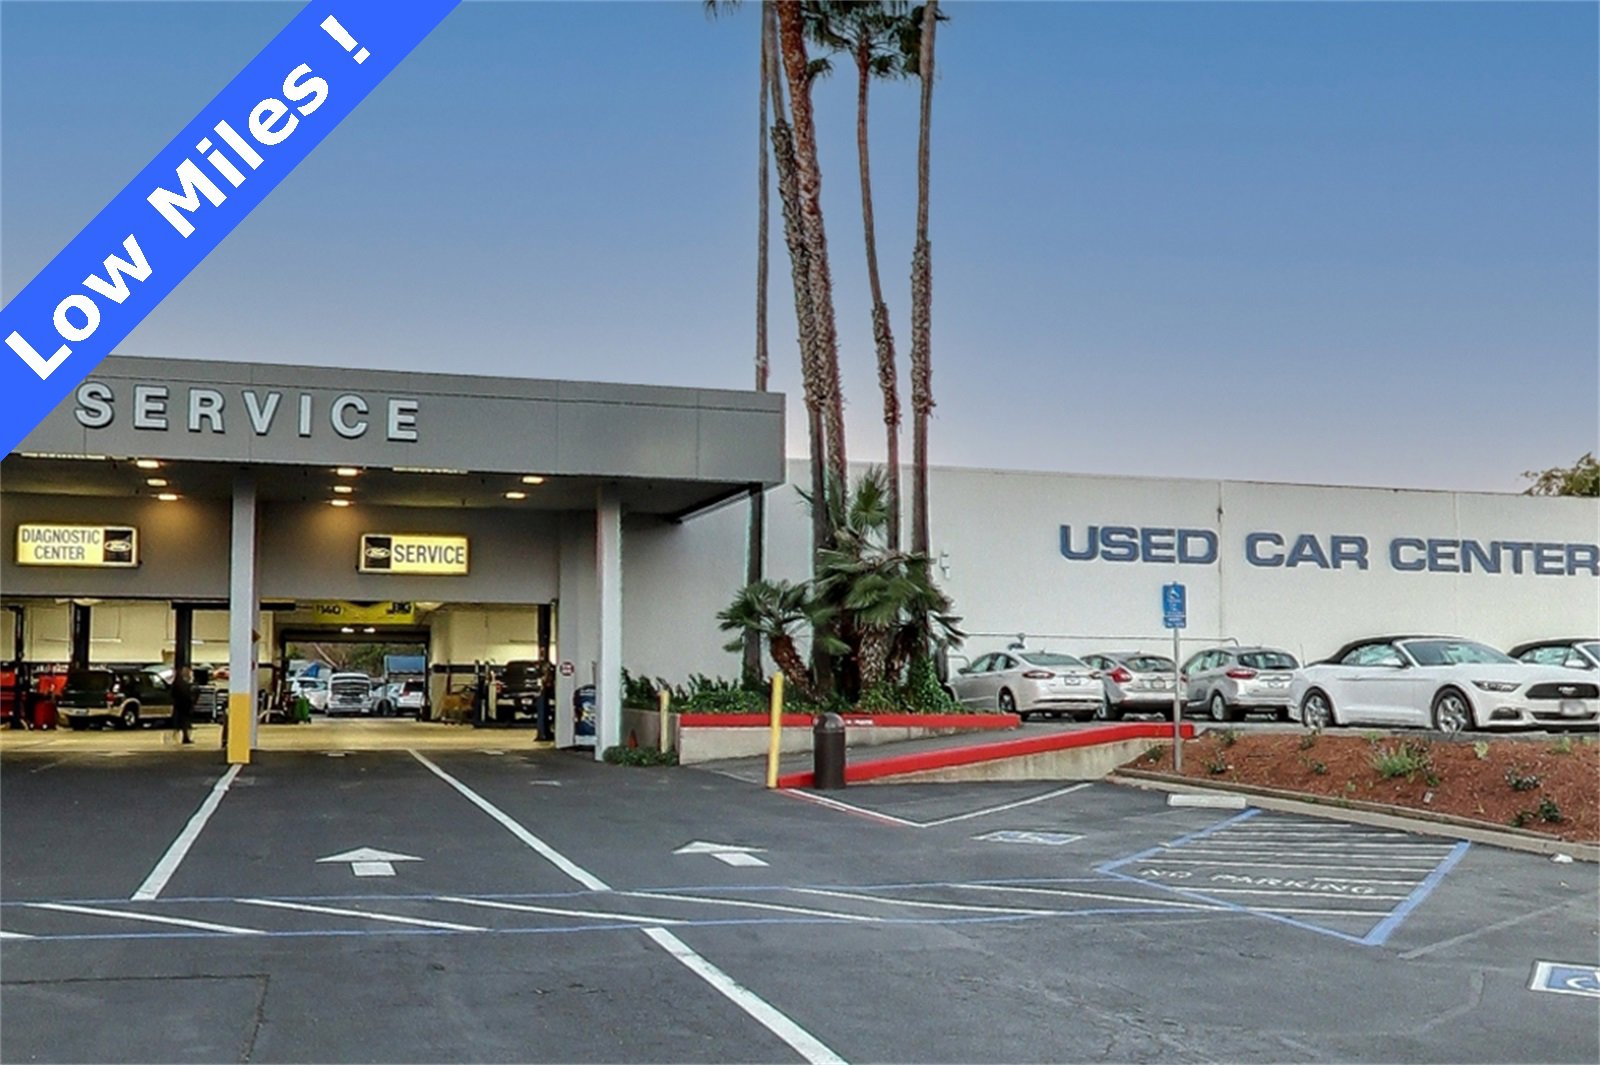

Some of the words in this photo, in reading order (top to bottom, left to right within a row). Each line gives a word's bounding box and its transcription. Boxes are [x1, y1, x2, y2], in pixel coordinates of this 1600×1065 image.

[75, 381, 419, 442] SERVICE
[21, 528, 101, 545] DIAGNOSTIC
[34, 545, 85, 560] CENTER
[394, 544, 465, 565] SERVICE
[1060, 525, 1218, 564] USED
[1245, 532, 1369, 570] CAR
[1389, 538, 1600, 576] CENTER
[1138, 868, 1192, 879] NO
[1211, 873, 1376, 895] PARKING
